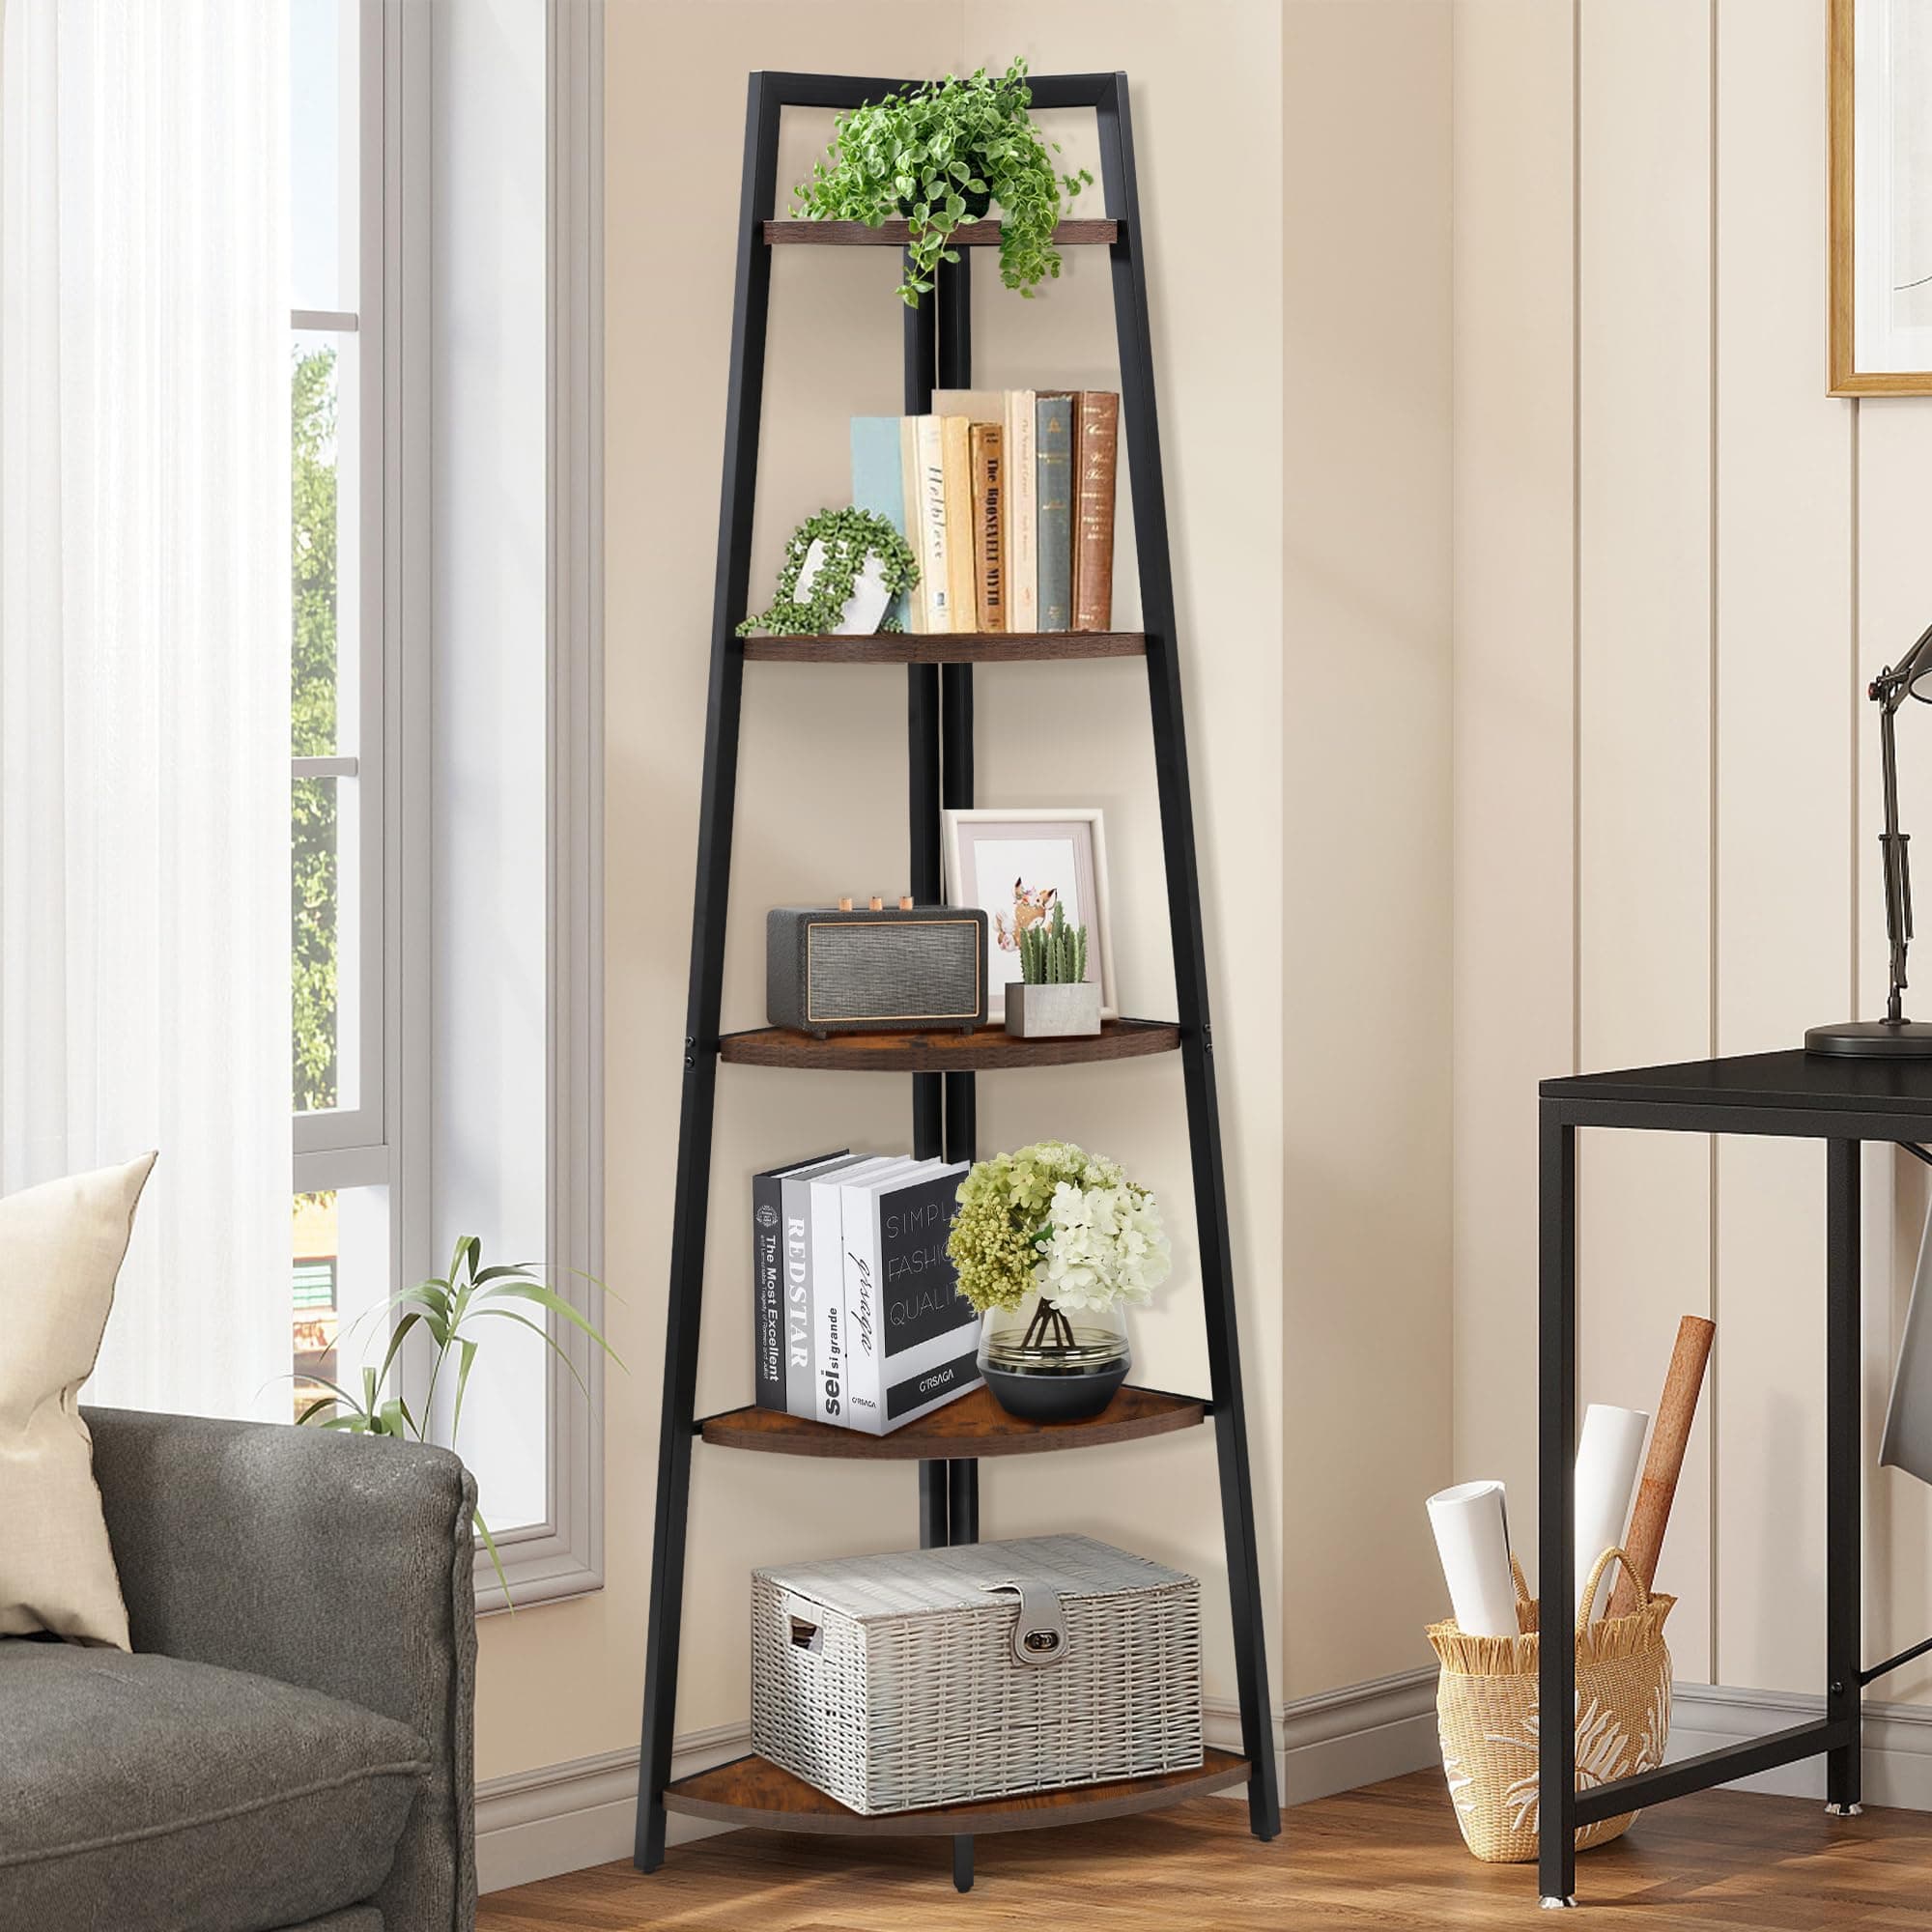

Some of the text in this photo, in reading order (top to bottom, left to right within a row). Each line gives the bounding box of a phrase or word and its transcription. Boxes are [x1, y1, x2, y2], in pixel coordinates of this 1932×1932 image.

[987, 459, 998, 481] The
[986, 568, 999, 606] MYTH
[886, 1202, 960, 1238] SIMPL
[766, 1235, 776, 1263] The
[767, 1267, 777, 1305] Most
[788, 1216, 808, 1367] REDSTAR
[890, 1282, 958, 1326] QUALIT
[768, 1309, 779, 1381] Excellent
[828, 1307, 840, 1369] si grande
[821, 1370, 840, 1416] sei
